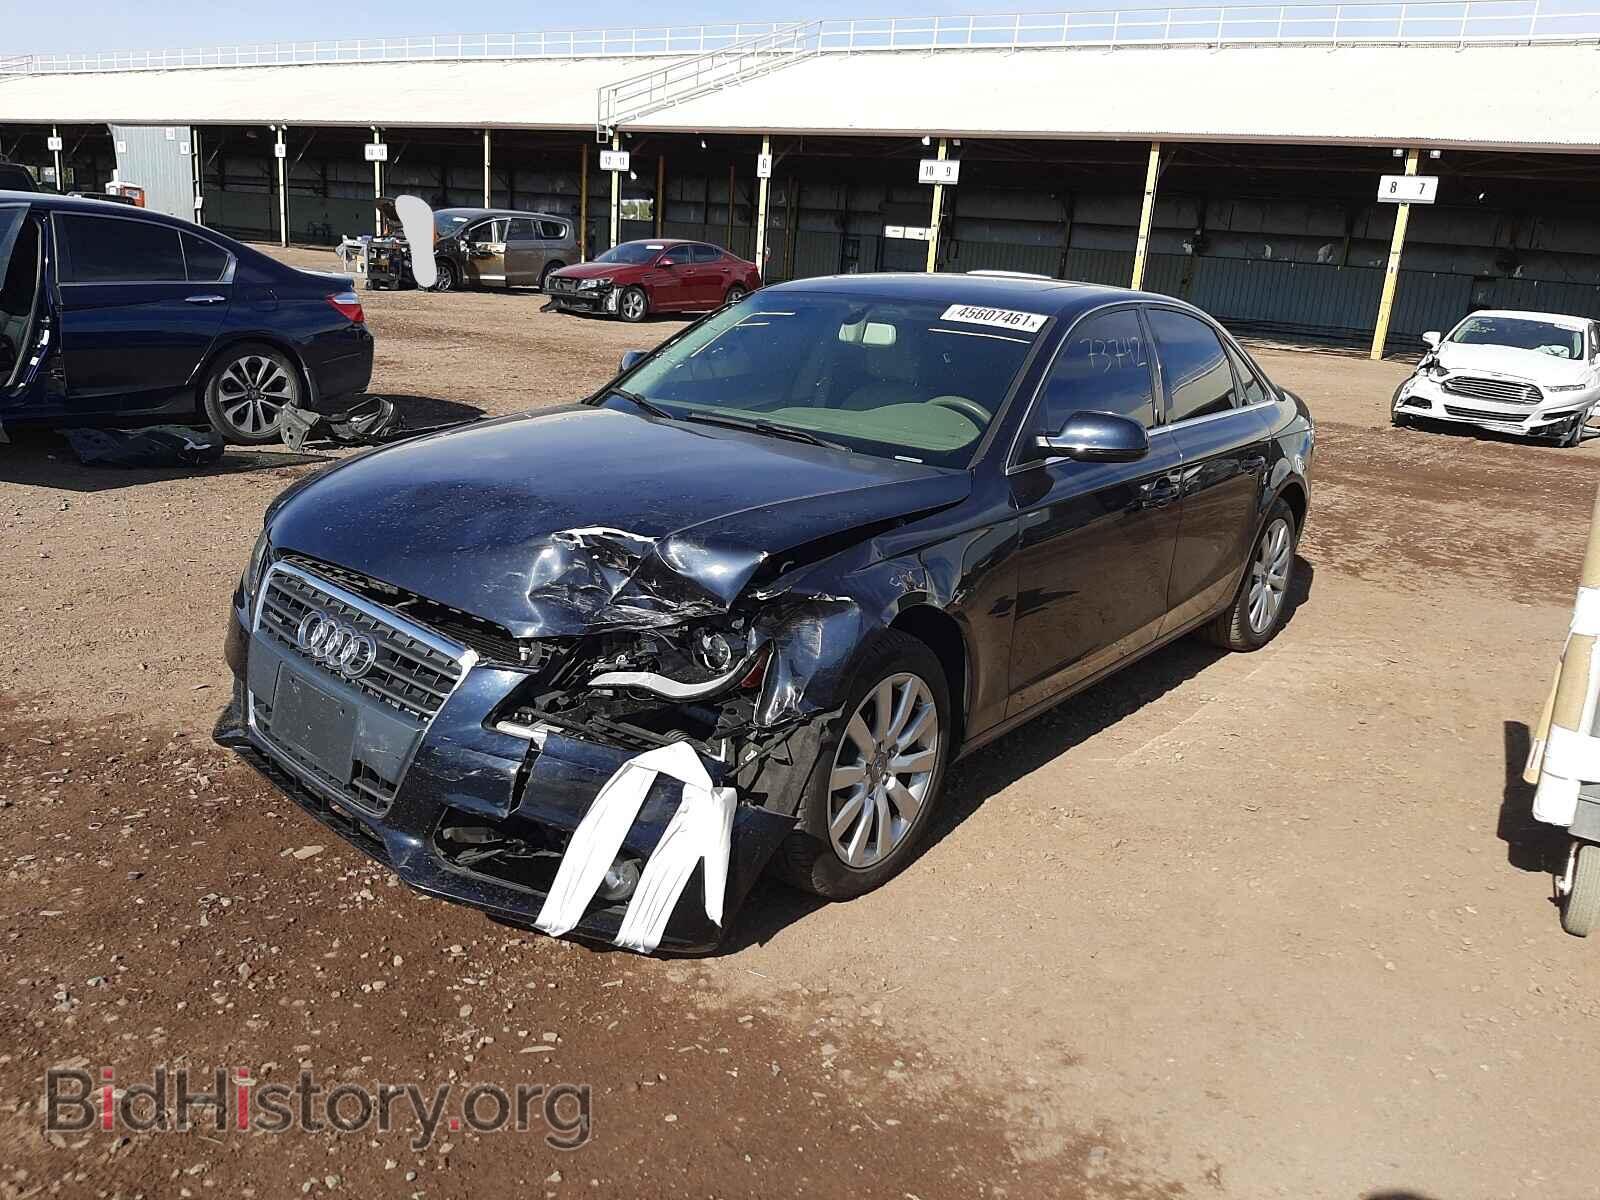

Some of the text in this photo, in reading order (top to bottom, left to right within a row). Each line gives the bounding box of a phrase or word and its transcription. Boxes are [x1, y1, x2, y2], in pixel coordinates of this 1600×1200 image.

[925, 166, 952, 177] 10 9
[1390, 181, 1426, 195] 8 7
[957, 306, 1032, 327] 45607461
